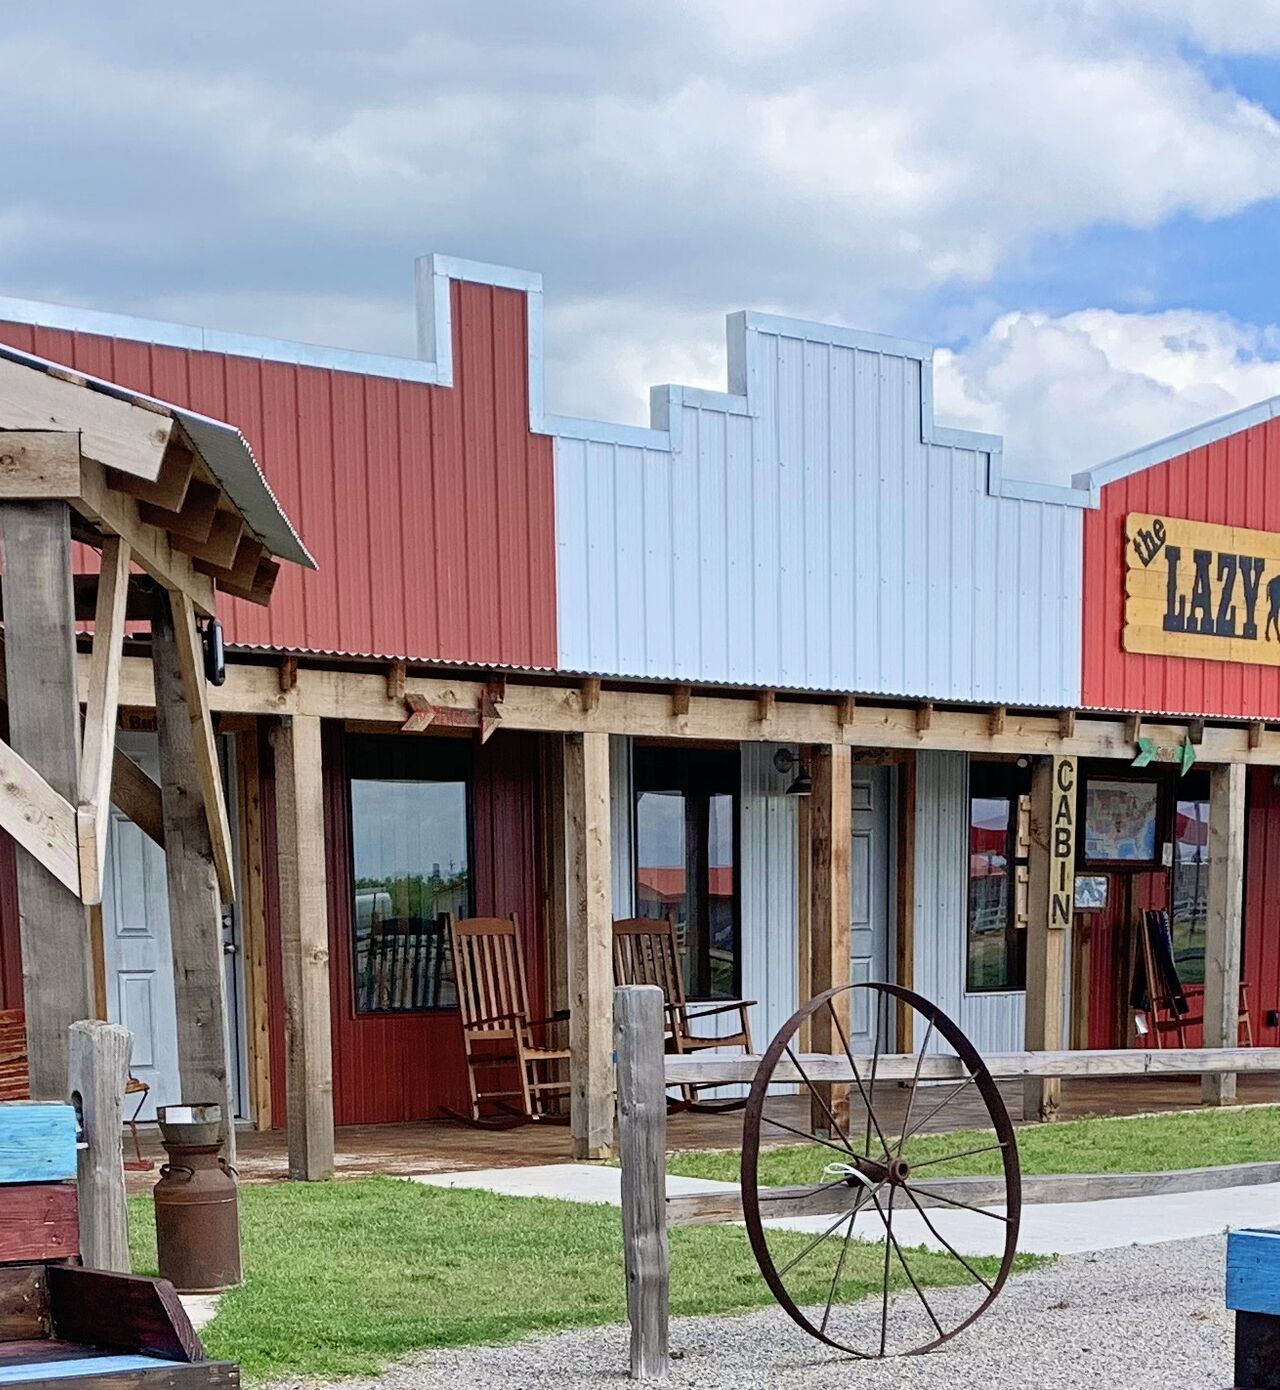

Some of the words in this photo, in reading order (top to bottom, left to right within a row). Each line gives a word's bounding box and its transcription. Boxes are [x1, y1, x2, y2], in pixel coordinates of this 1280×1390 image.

[1134, 518, 1167, 567] the
[1162, 546, 1265, 640] LAZY
[1052, 760, 1073, 925] CABIN
